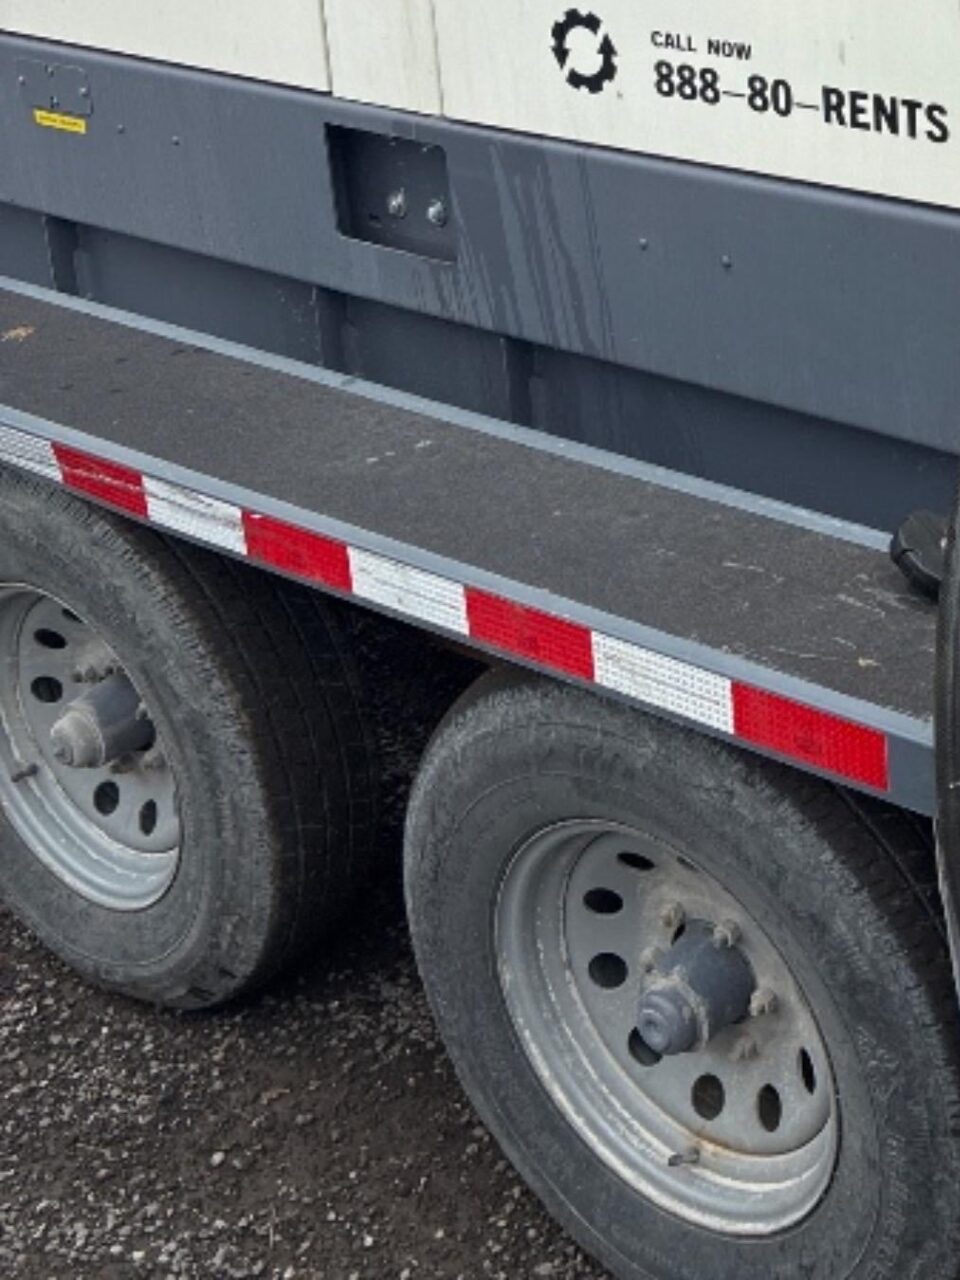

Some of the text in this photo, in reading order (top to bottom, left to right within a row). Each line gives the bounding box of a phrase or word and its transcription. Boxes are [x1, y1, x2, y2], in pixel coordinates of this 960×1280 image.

[650, 30, 752, 60] CALL NOW
[654, 60, 950, 143] 888-80-RENTS
